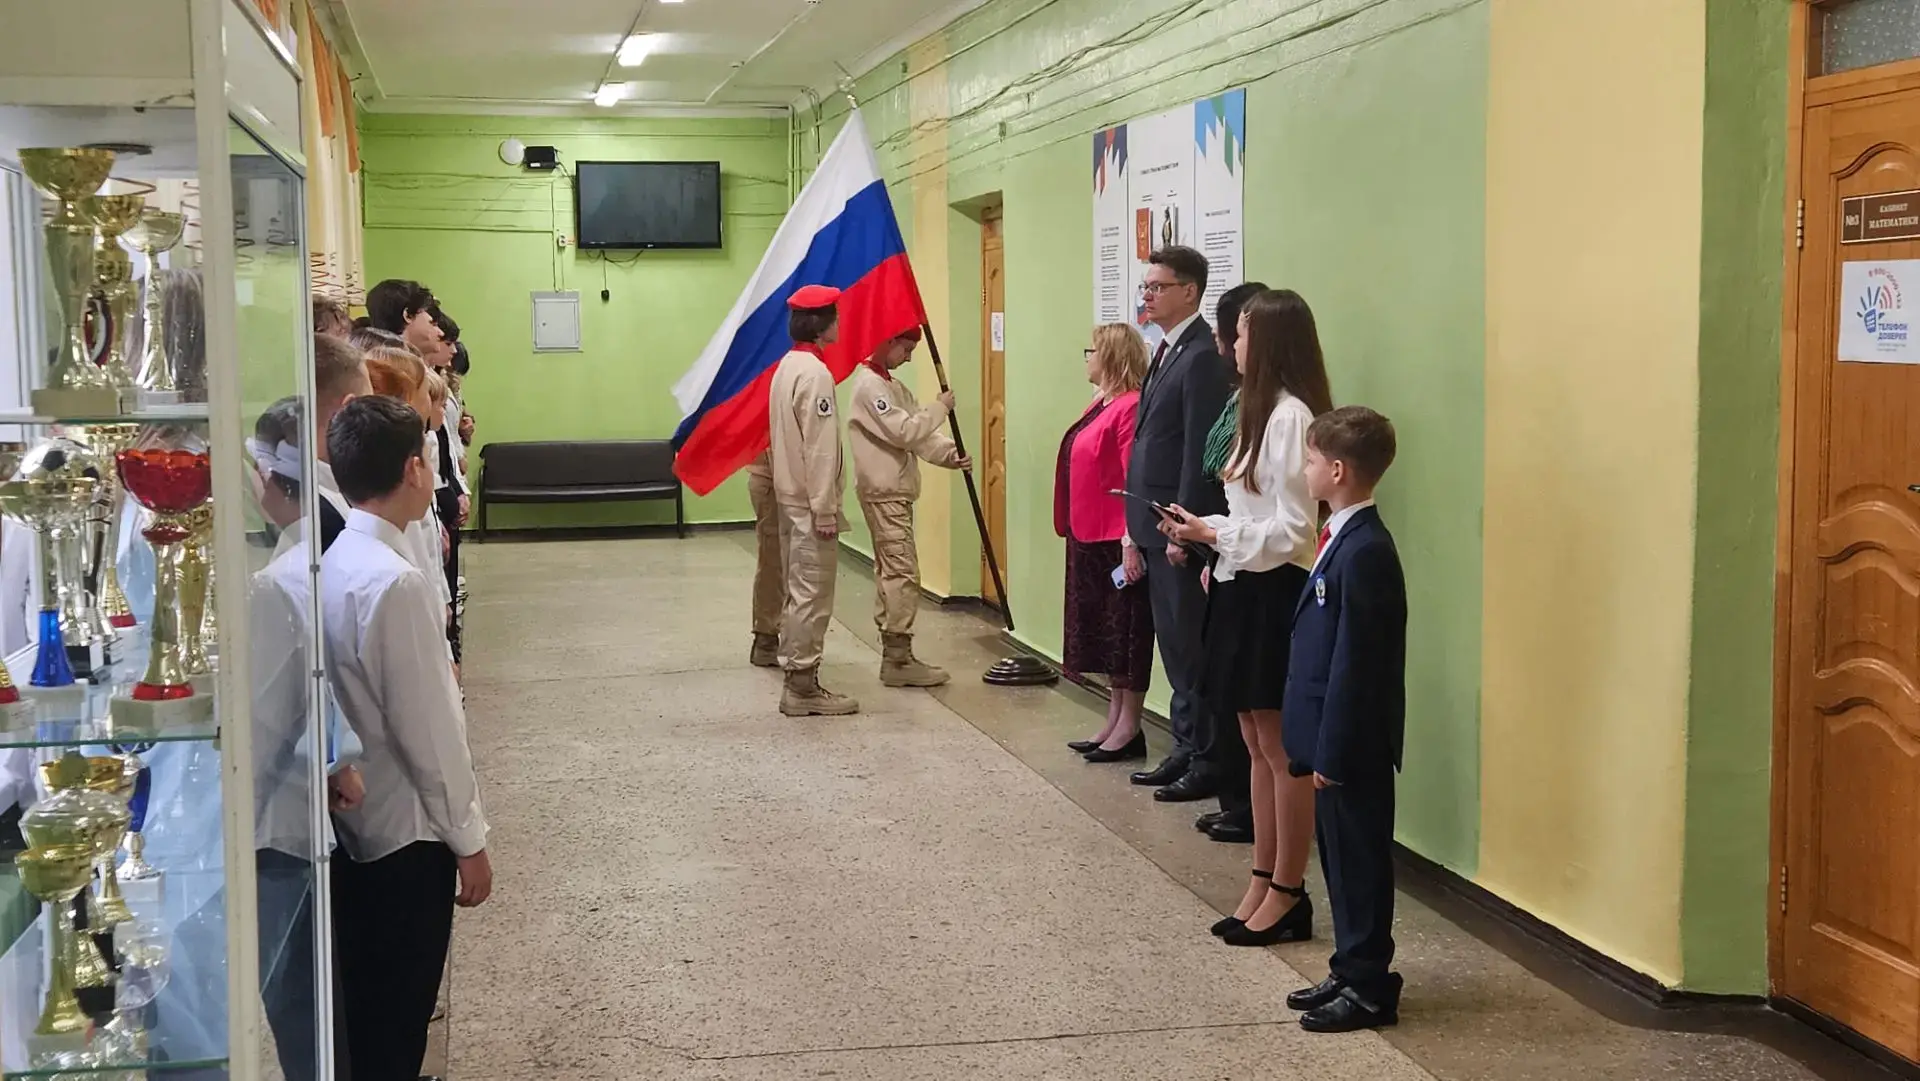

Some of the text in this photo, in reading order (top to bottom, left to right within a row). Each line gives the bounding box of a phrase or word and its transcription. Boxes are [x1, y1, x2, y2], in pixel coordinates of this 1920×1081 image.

[1868, 216, 1919, 230] МАТЕМАТИКИ
[1878, 323, 1909, 331] ТЕЛЕФОН
[1877, 332, 1908, 341] ДОВЕРИЯ
